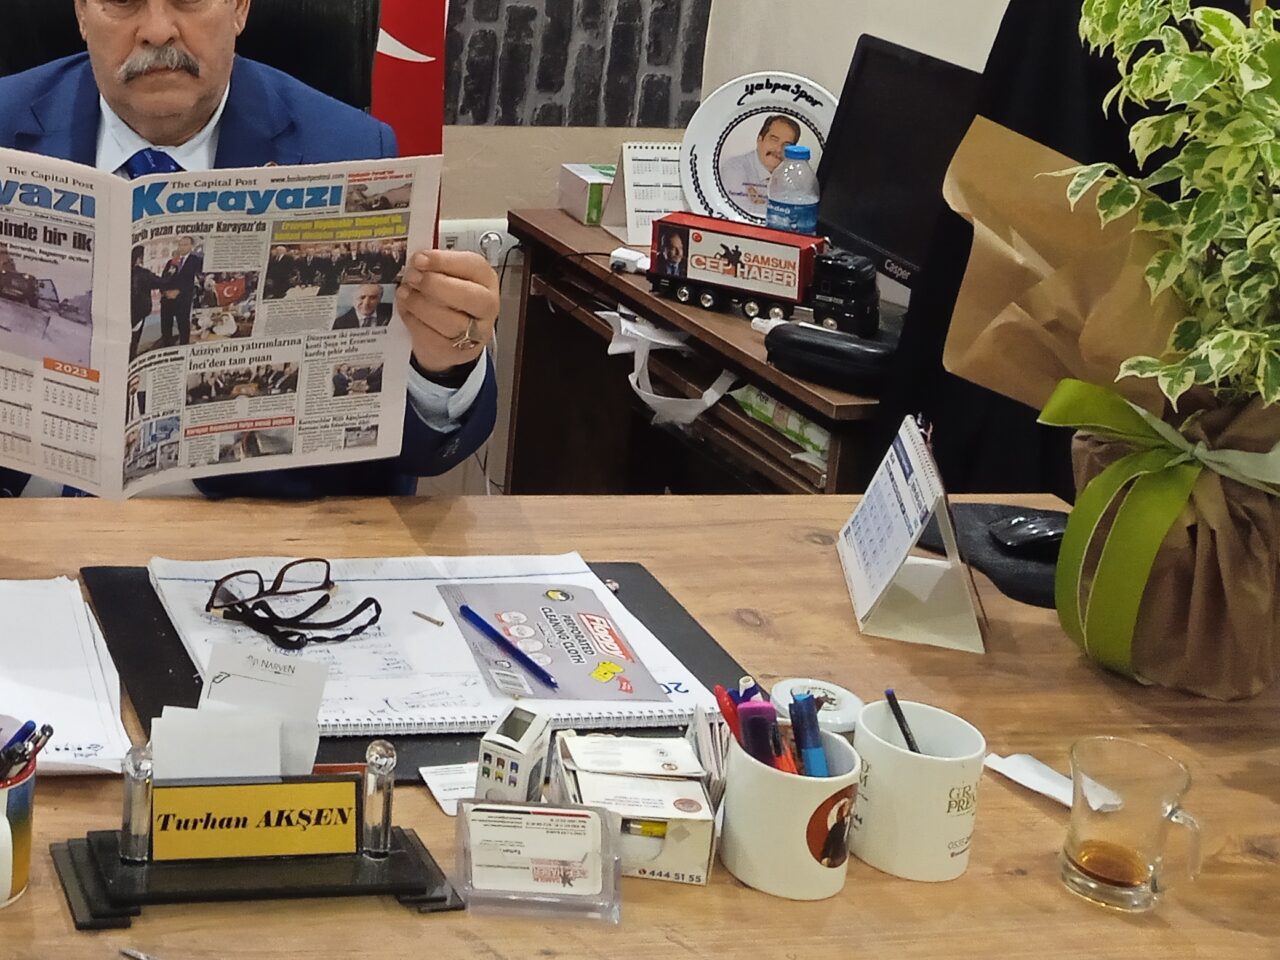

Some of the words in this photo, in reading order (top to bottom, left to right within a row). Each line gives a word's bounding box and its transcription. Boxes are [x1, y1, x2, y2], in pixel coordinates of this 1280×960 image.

[6, 166, 27, 176] The
[30, 170, 69, 183] Capital
[72, 177, 94, 190] Post
[170, 181, 191, 189] The
[193, 178, 232, 189] Capital
[234, 178, 257, 187] Post
[131, 181, 344, 223] Karayazı
[42, 225, 68, 246] bir
[72, 231, 93, 252] ilk
[150, 225, 173, 239] yazan
[175, 222, 214, 235] çocuklar
[744, 252, 797, 271] SAMSUN
[884, 259, 912, 280] Casper
[736, 262, 797, 288] HABER
[188, 343, 239, 358] Aziziye'nin
[239, 338, 302, 353] yatırımlarına
[55, 362, 89, 379] 2023
[188, 358, 227, 371] İnci'den
[228, 355, 247, 366] tam
[247, 353, 273, 366] puan
[540, 606, 569, 640] CLEANING
[562, 641, 585, 665] CLOTH
[561, 614, 595, 656] PERFORATED
[260, 659, 297, 675] NARVEN
[157, 811, 249, 832] Turhan
[256, 806, 353, 831] AKŞEN
[649, 869, 670, 879] 444
[674, 872, 685, 881] 51
[688, 874, 702, 883] 55
